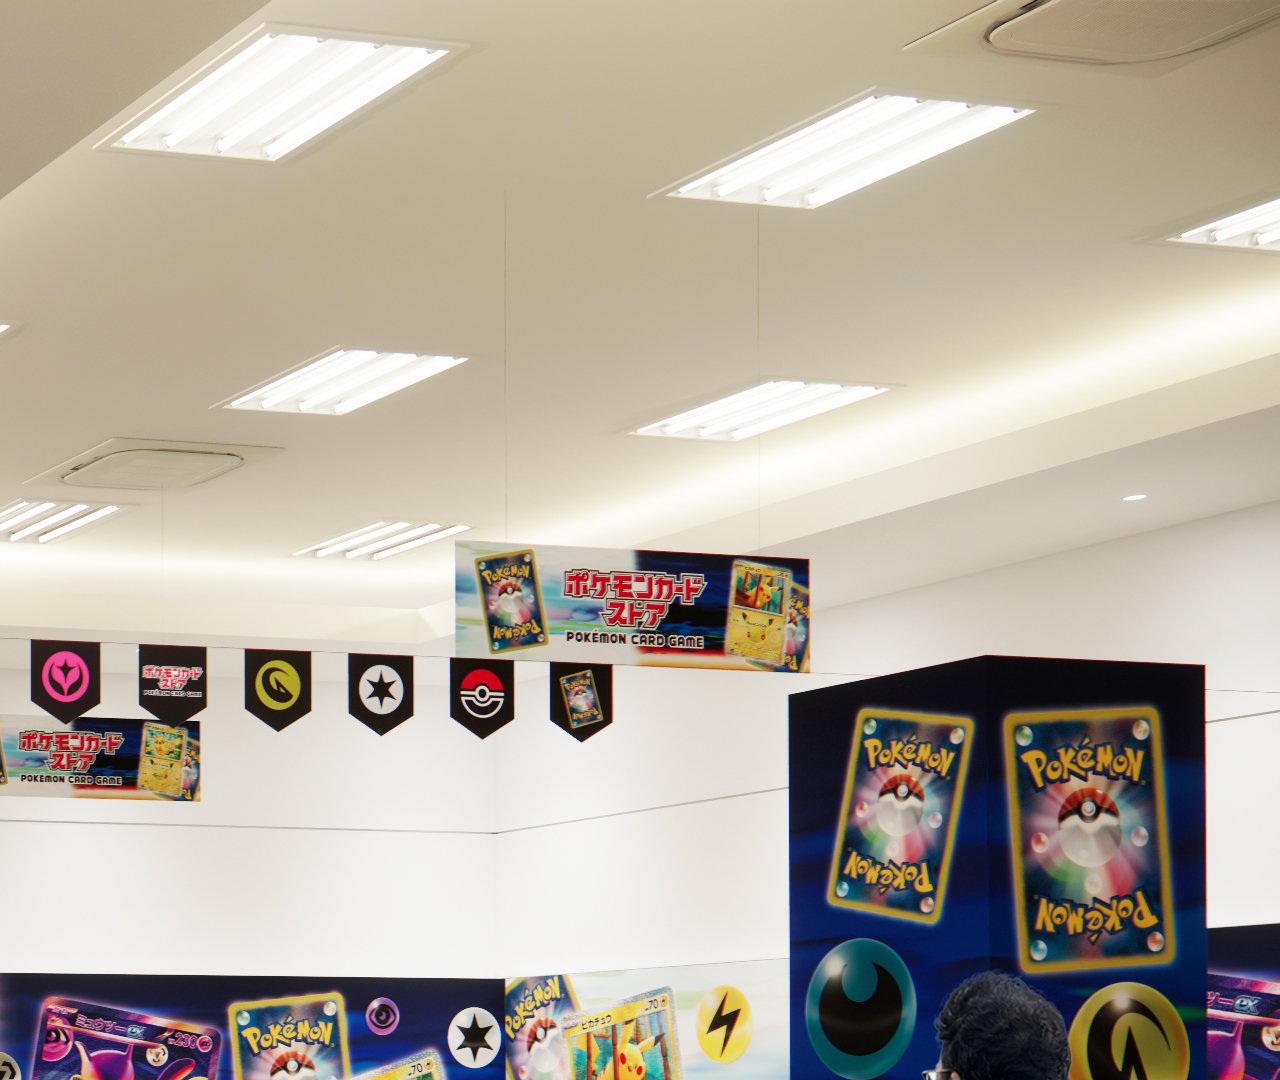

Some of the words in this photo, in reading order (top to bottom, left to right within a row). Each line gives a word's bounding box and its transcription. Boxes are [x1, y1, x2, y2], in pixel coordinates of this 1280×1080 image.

[565, 571, 704, 603] ポケモンカード
[603, 599, 668, 627] ストア
[566, 629, 625, 644] POKÉMON
[631, 634, 664, 646] CARD
[667, 636, 704, 648] GAME
[18, 731, 123, 754] ポケモンカード
[47, 752, 95, 771] ストア
[649, 998, 659, 1011] 70
[410, 1063, 423, 1075] 70
